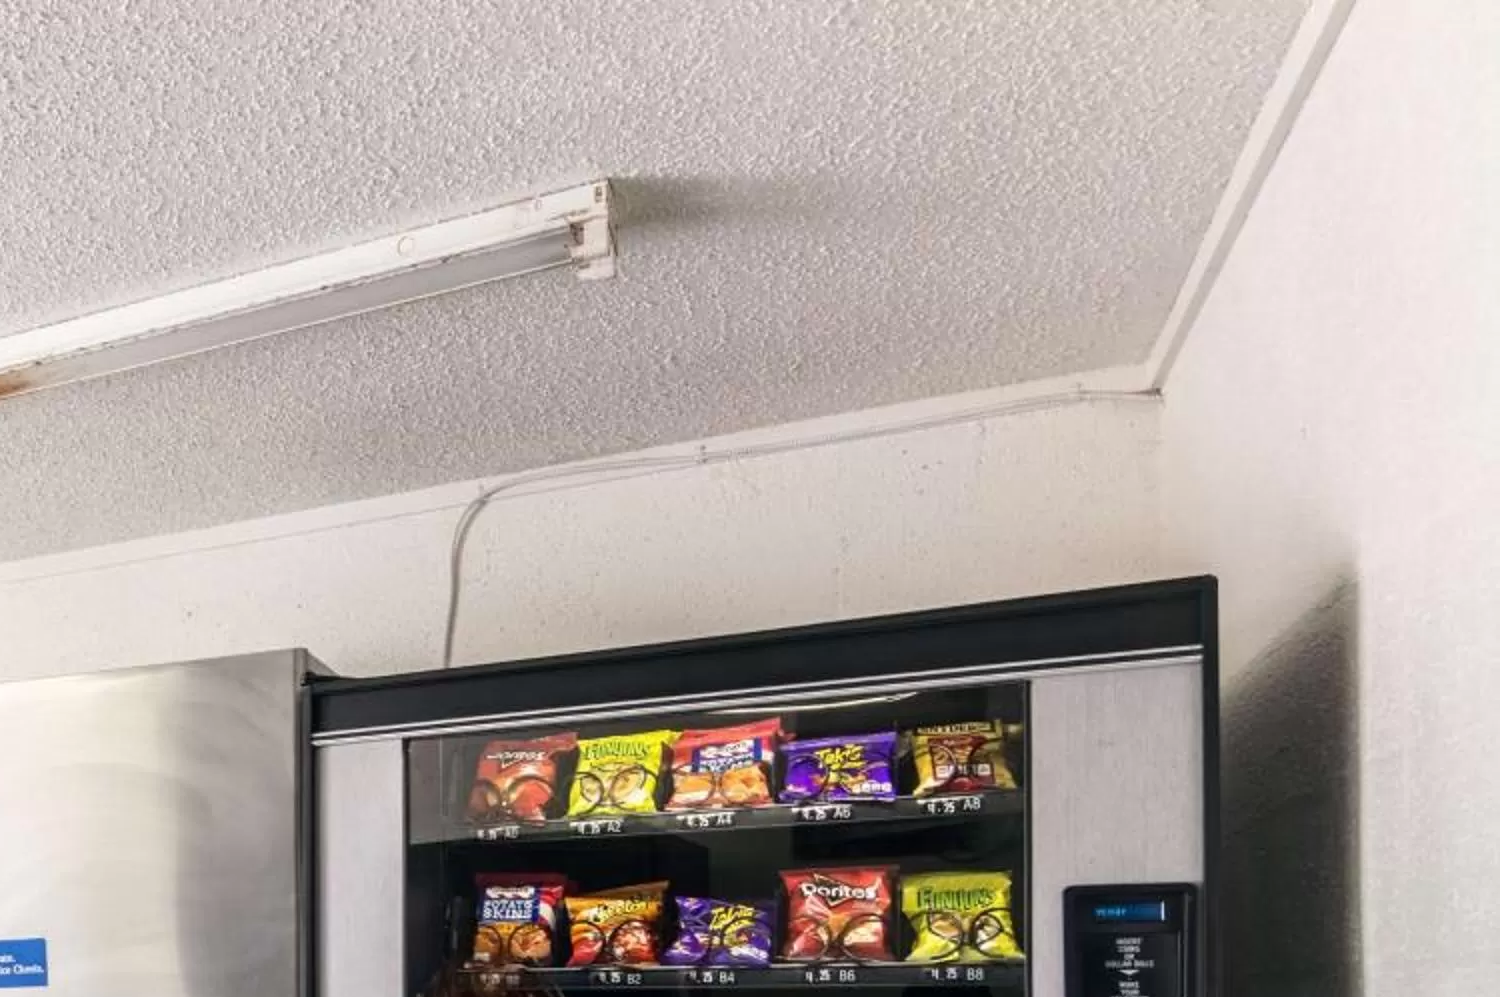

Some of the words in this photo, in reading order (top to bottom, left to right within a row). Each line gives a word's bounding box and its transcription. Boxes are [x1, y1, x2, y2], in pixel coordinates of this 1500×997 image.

[801, 883, 878, 901] Doritos
[627, 973, 642, 985] B2
[839, 970, 855, 982] B6
[967, 969, 984, 981] B8
